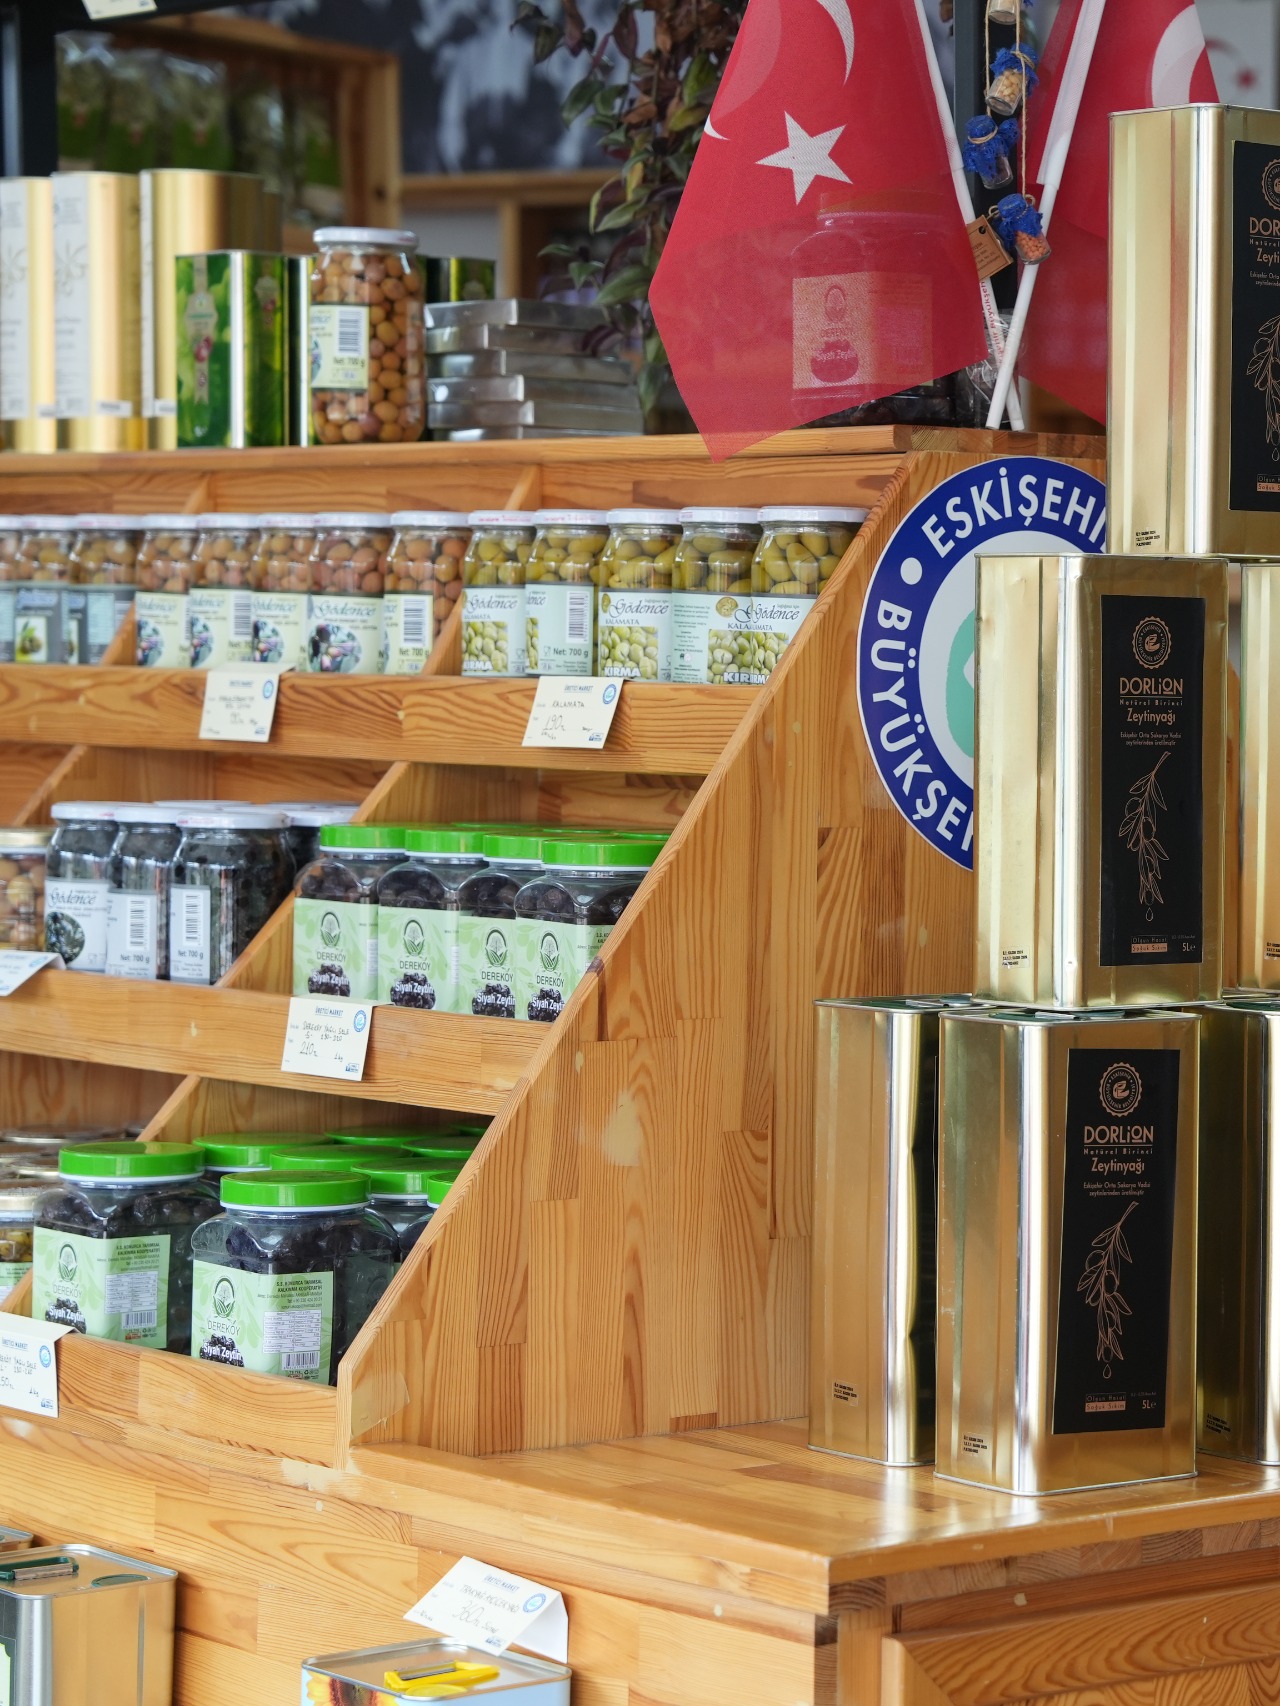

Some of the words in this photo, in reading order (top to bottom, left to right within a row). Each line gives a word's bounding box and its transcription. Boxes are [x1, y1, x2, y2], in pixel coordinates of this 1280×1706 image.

[922, 467, 1106, 558] ESKİŞEHİ
[609, 598, 669, 619] Gödence
[569, 648, 582, 656] 700
[584, 650, 588, 658] g
[1127, 708, 1176, 726] Zeytinyağı
[188, 950, 198, 958] 700
[313, 974, 330, 985] Siyah
[396, 982, 412, 993] Siyah
[477, 992, 495, 1006] Siyah
[532, 997, 549, 1010] Siyah
[328, 1008, 344, 1016] MARKET
[1092, 1158, 1144, 1176] Zeytinyağı
[49, 1306, 66, 1318] Siyah
[203, 1342, 220, 1356] Siyah
